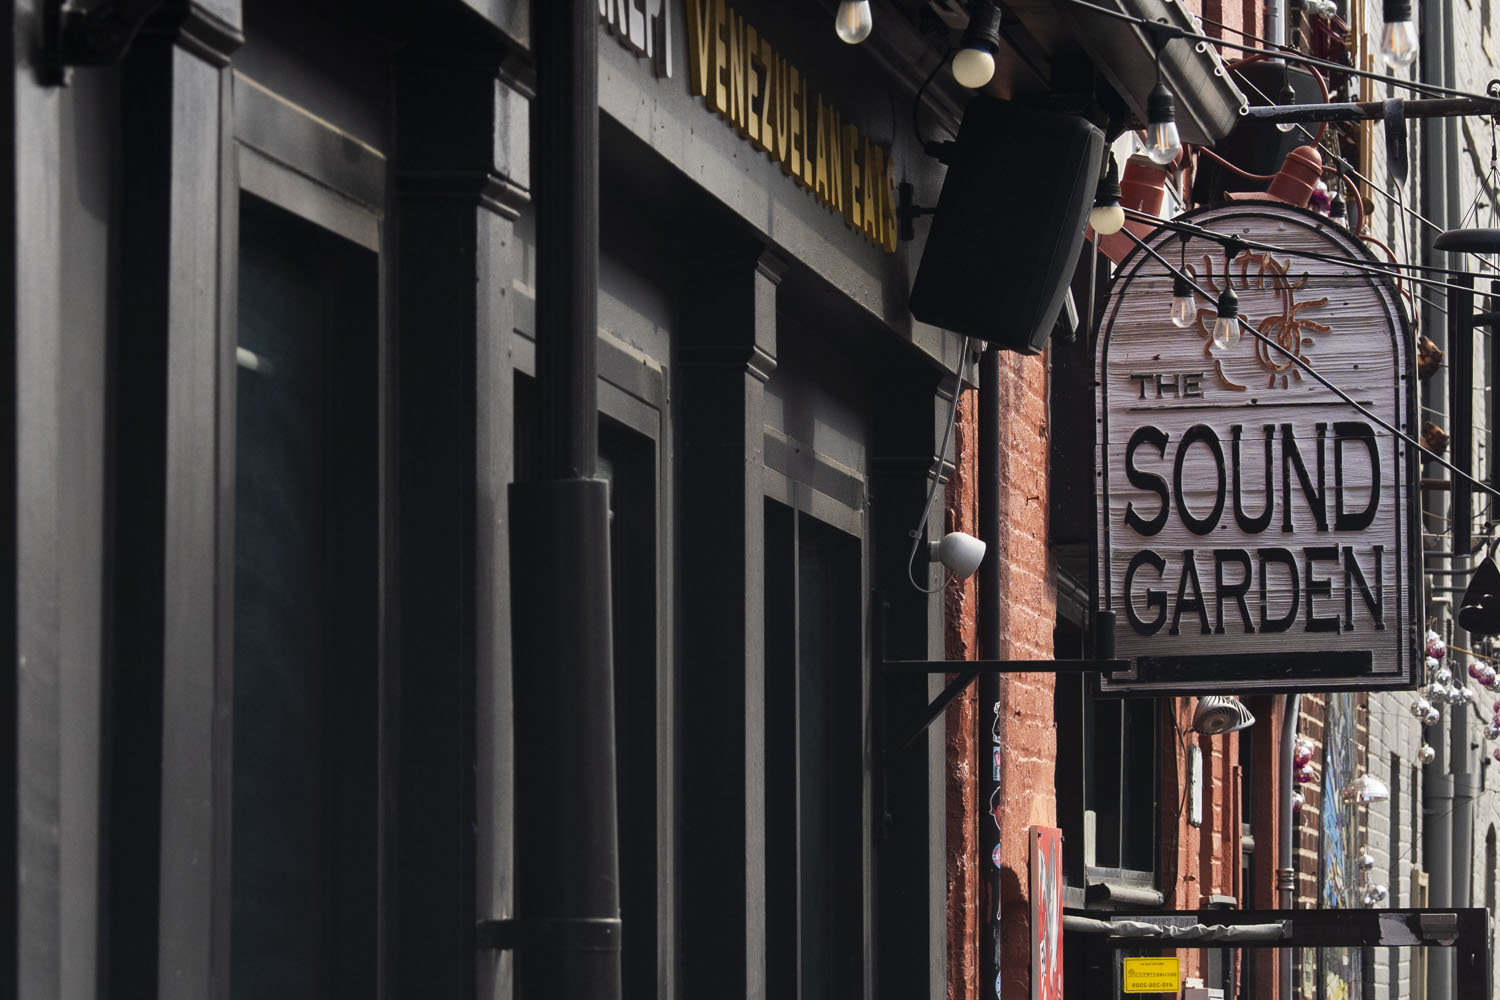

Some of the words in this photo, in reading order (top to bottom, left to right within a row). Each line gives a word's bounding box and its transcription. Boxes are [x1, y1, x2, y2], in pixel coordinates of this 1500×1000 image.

[690, 0, 843, 213] VENEZUELAN
[847, 125, 898, 253] EATS
[1130, 372, 1205, 399] THE
[1124, 421, 1382, 537] SOUND
[1124, 543, 1387, 637] GARDEN
